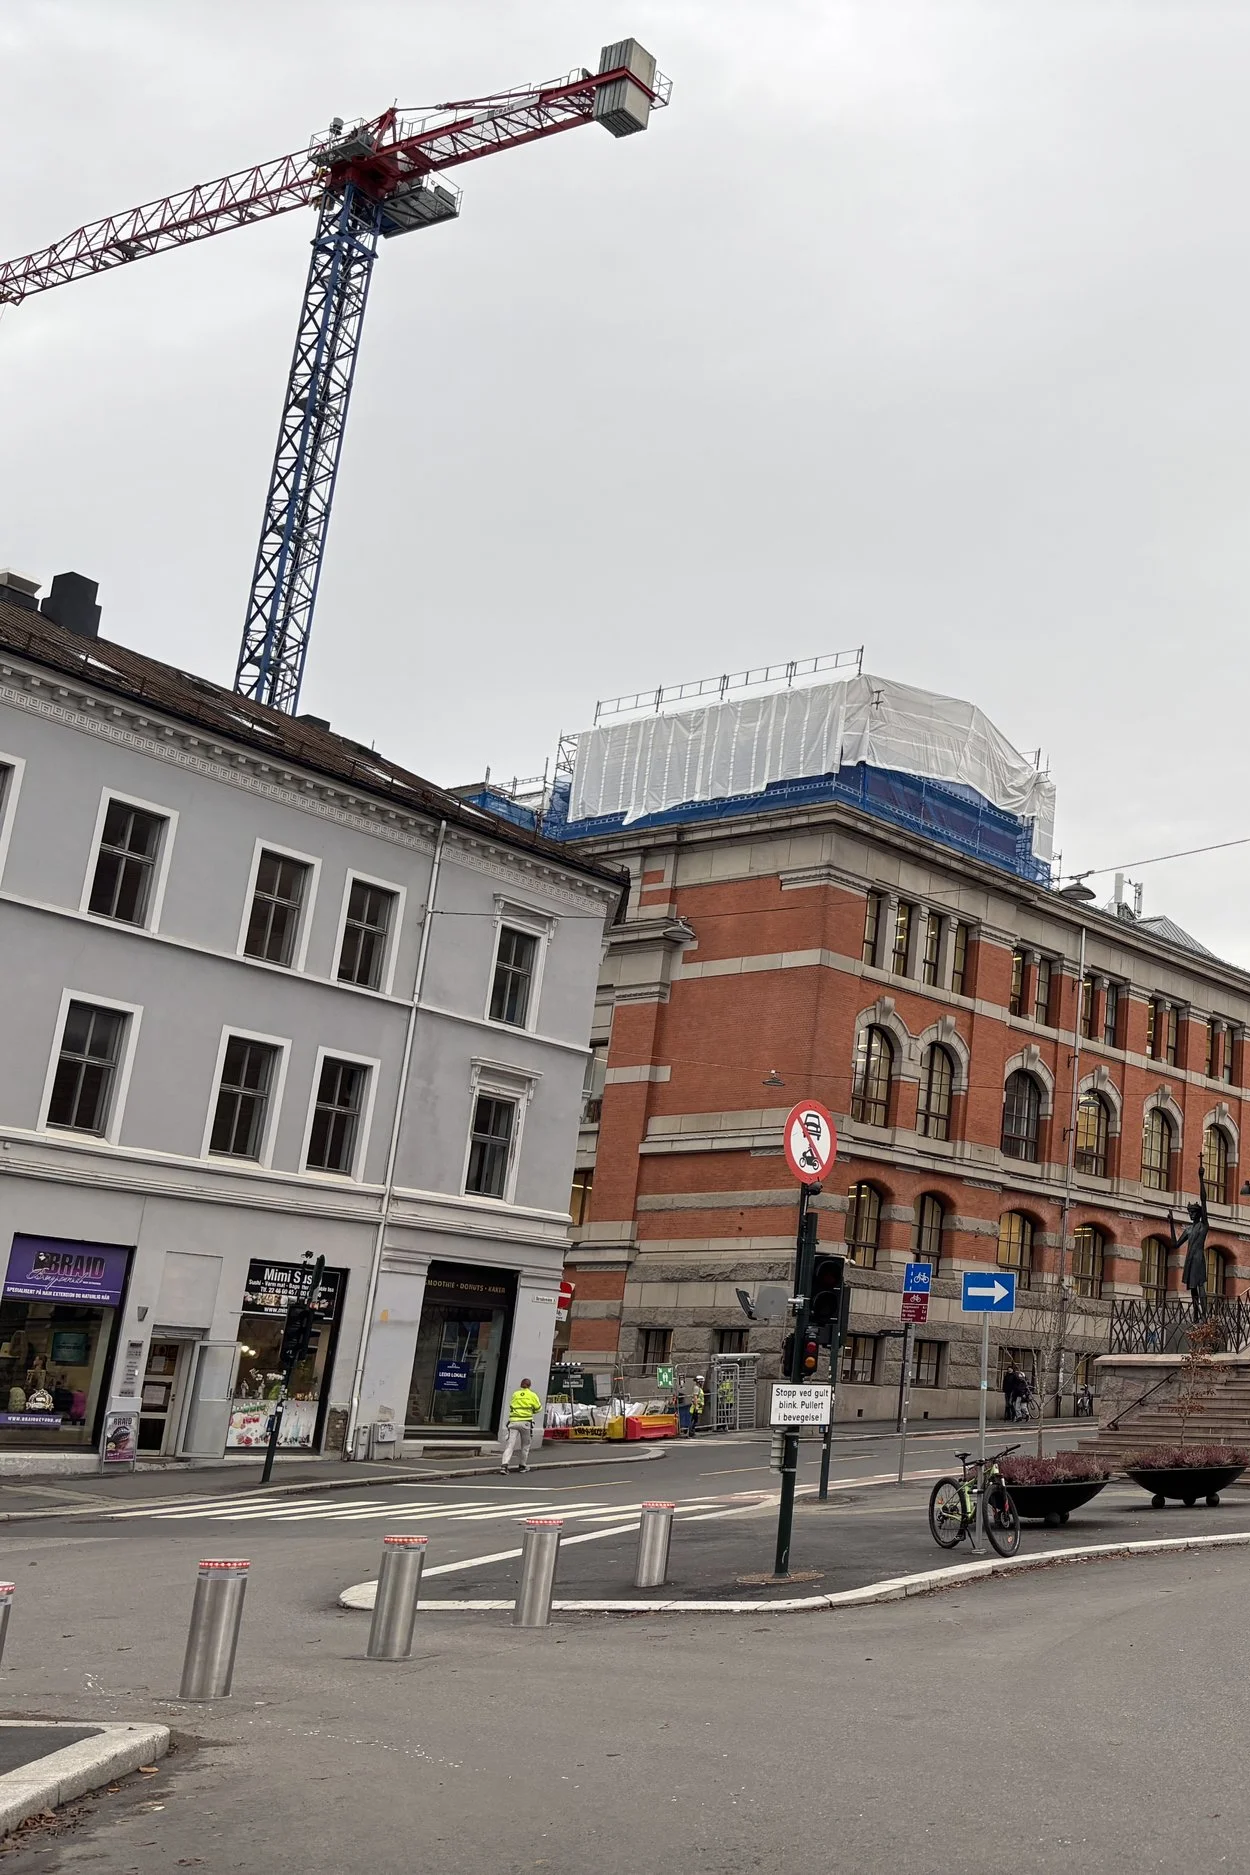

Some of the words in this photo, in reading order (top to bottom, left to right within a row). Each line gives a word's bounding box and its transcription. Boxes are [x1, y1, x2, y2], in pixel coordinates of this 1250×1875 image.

[494, 104, 514, 115] CRANE
[48, 1252, 106, 1280] BRAID
[264, 1267, 292, 1283] Mimi
[459, 1283, 484, 1292] DONUTS
[775, 1387, 797, 1398] Stopp
[799, 1389, 812, 1397] ved
[814, 1388, 829, 1399] gult
[779, 1400, 799, 1409] blink.
[800, 1400, 824, 1410] Pullert
[113, 1417, 133, 1427] BRAID
[783, 1412, 823, 1424] bevegelse!
